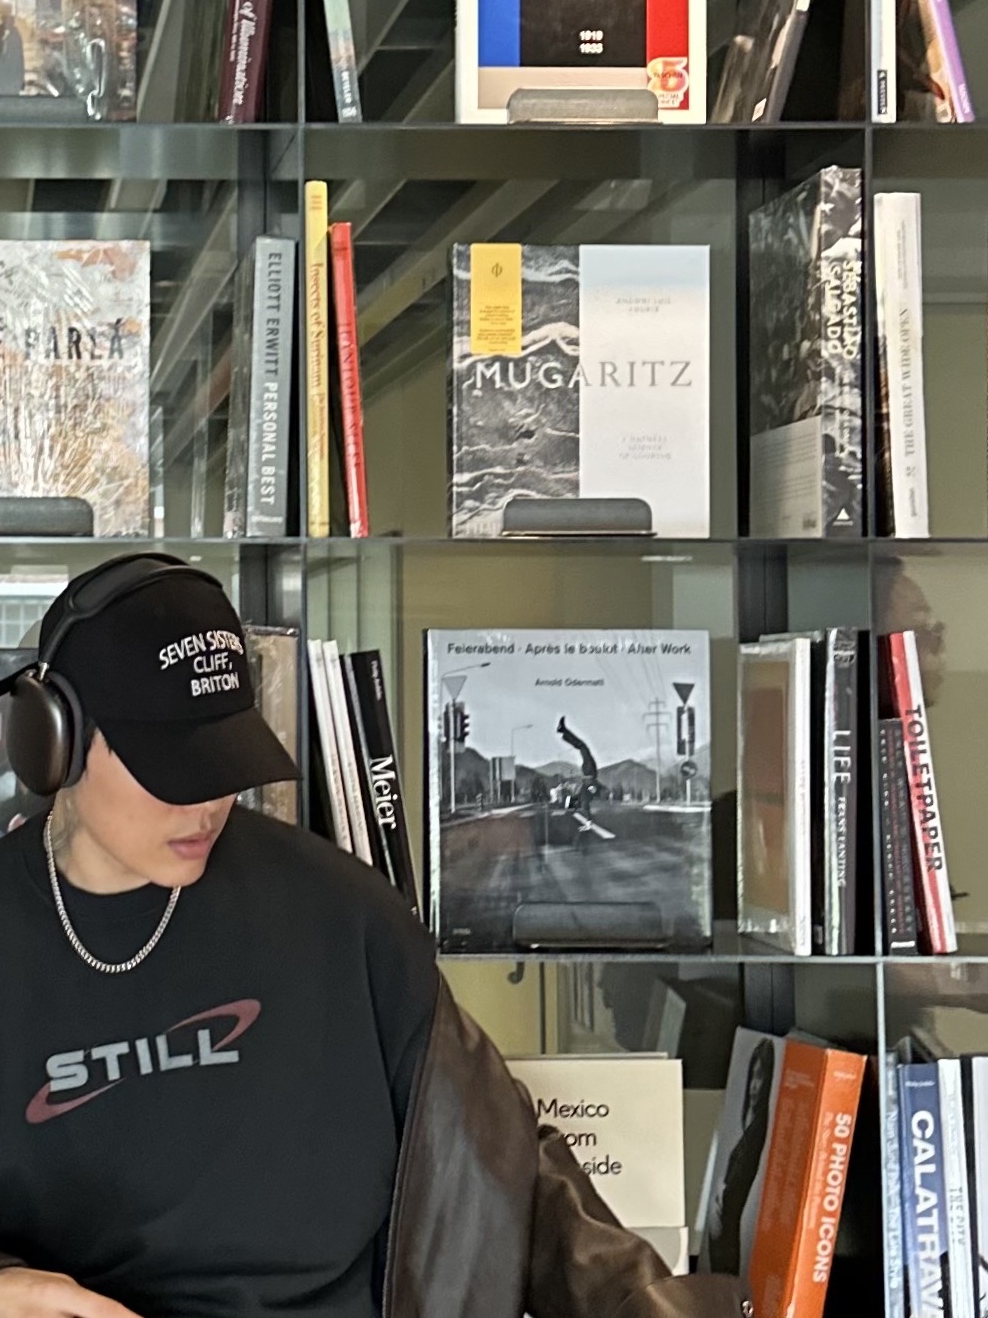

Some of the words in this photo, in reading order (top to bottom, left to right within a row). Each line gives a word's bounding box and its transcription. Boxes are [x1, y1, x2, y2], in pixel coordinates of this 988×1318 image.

[232, 19, 256, 105] Illumination
[264, 253, 283, 314] ELLIOTT
[827, 263, 843, 355] SALGADO
[898, 307, 911, 343] OPEN
[262, 317, 280, 376] ERWITT
[900, 344, 913, 382] WIDE
[475, 360, 694, 389] MUGARITZ
[259, 381, 279, 463] PERSONAL
[902, 384, 915, 428] GREAT
[903, 429, 916, 458] THE
[258, 465, 276, 505] BEST
[159, 633, 207, 670] SEVEN
[193, 651, 233, 674] CLIFF,
[446, 642, 515, 655] Feierabend
[524, 642, 560, 656] Après
[563, 642, 576, 655] le
[660, 643, 692, 655] Work
[191, 671, 240, 697] BRITON
[832, 729, 852, 785] LIFE
[368, 755, 399, 832] Meier
[905, 704, 944, 873] TOILETPAPER
[45, 1028, 240, 1093] STILL
[537, 1098, 610, 1119] Mexico
[833, 1112, 853, 1138] 50
[822, 1142, 846, 1212] PHOTO
[811, 1216, 837, 1284] ICONS
